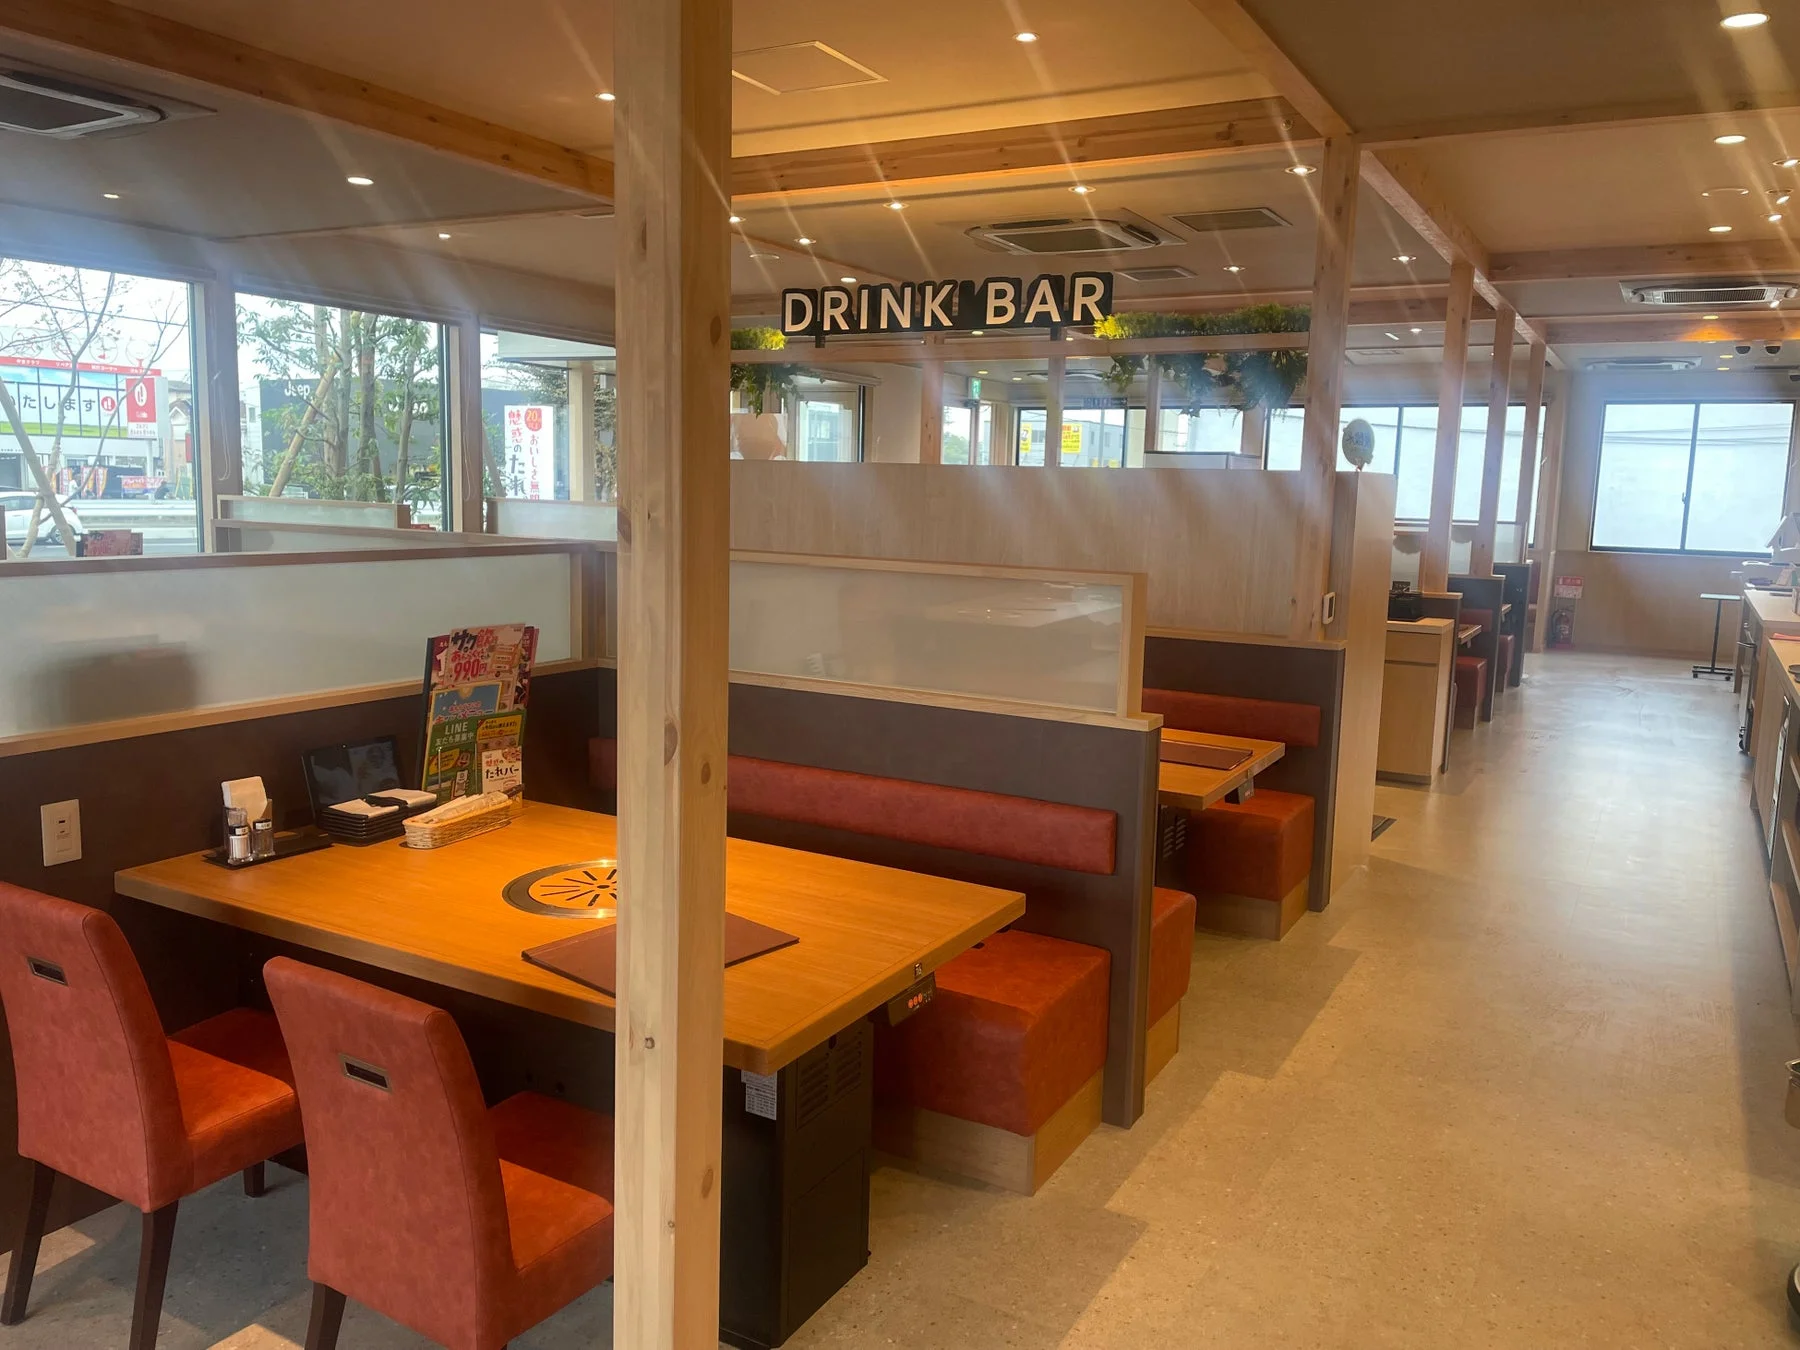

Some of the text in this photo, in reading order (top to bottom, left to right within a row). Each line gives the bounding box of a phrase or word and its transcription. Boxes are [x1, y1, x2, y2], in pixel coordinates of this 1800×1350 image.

[785, 276, 1106, 332] DRINK BAR
[284, 380, 310, 400] Jeep
[10, 394, 96, 412] たします
[445, 722, 469, 735] LINE
[485, 764, 520, 779] たれバー
